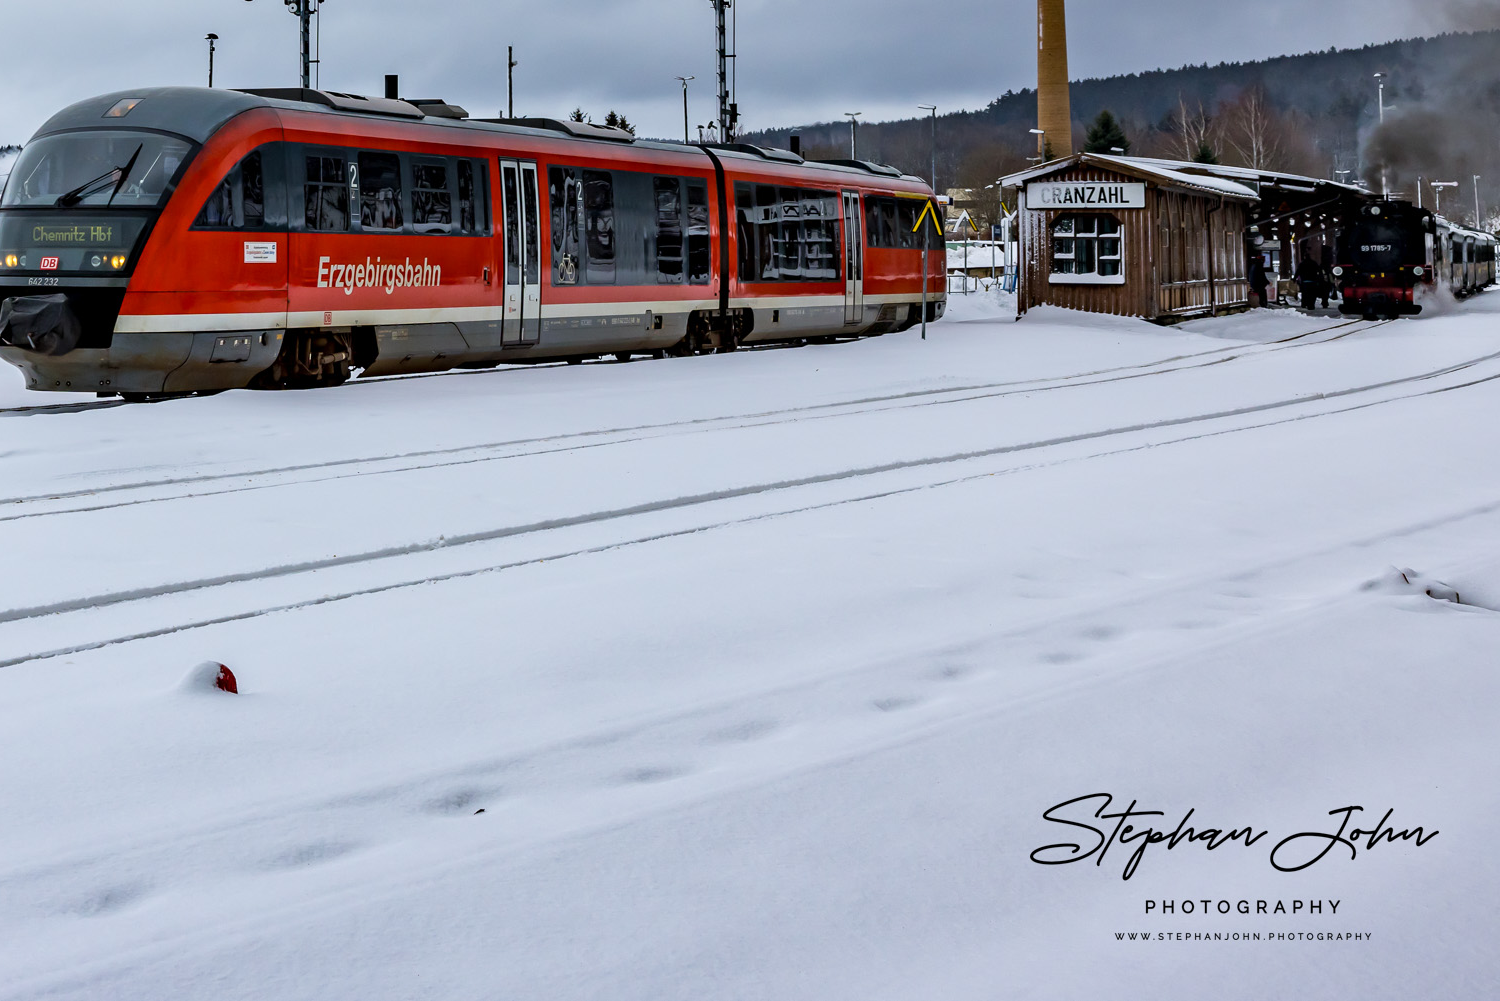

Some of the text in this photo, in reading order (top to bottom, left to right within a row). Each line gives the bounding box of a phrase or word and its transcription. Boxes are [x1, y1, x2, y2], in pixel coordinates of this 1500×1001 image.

[350, 165, 357, 187] 2
[577, 181, 582, 200] 2
[1041, 186, 1130, 204] CRANZAHL
[32, 226, 112, 241] Chemnitz Hbf
[41, 258, 58, 269] DB
[28, 277, 59, 286] 642 232
[317, 256, 441, 295] Erzgebirgsbahn
